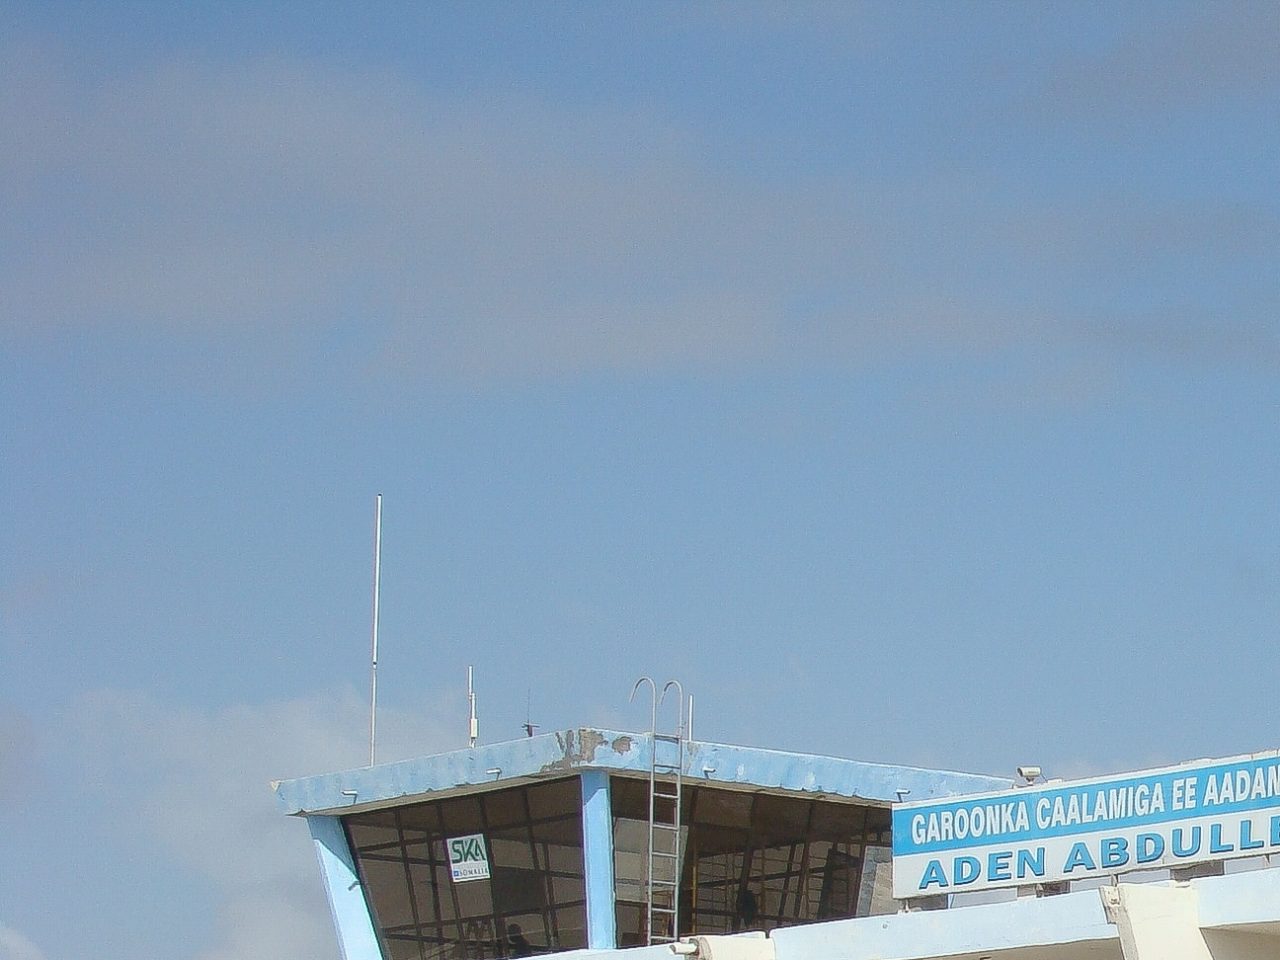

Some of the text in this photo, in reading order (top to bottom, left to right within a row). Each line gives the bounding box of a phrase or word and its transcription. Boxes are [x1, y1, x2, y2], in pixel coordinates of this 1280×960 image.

[911, 806, 1030, 845] GAROONKA
[1035, 785, 1165, 829] CAALAMIGA
[1171, 777, 1197, 808] EE
[452, 839, 486, 863] SKA
[919, 848, 1046, 890] ADEN
